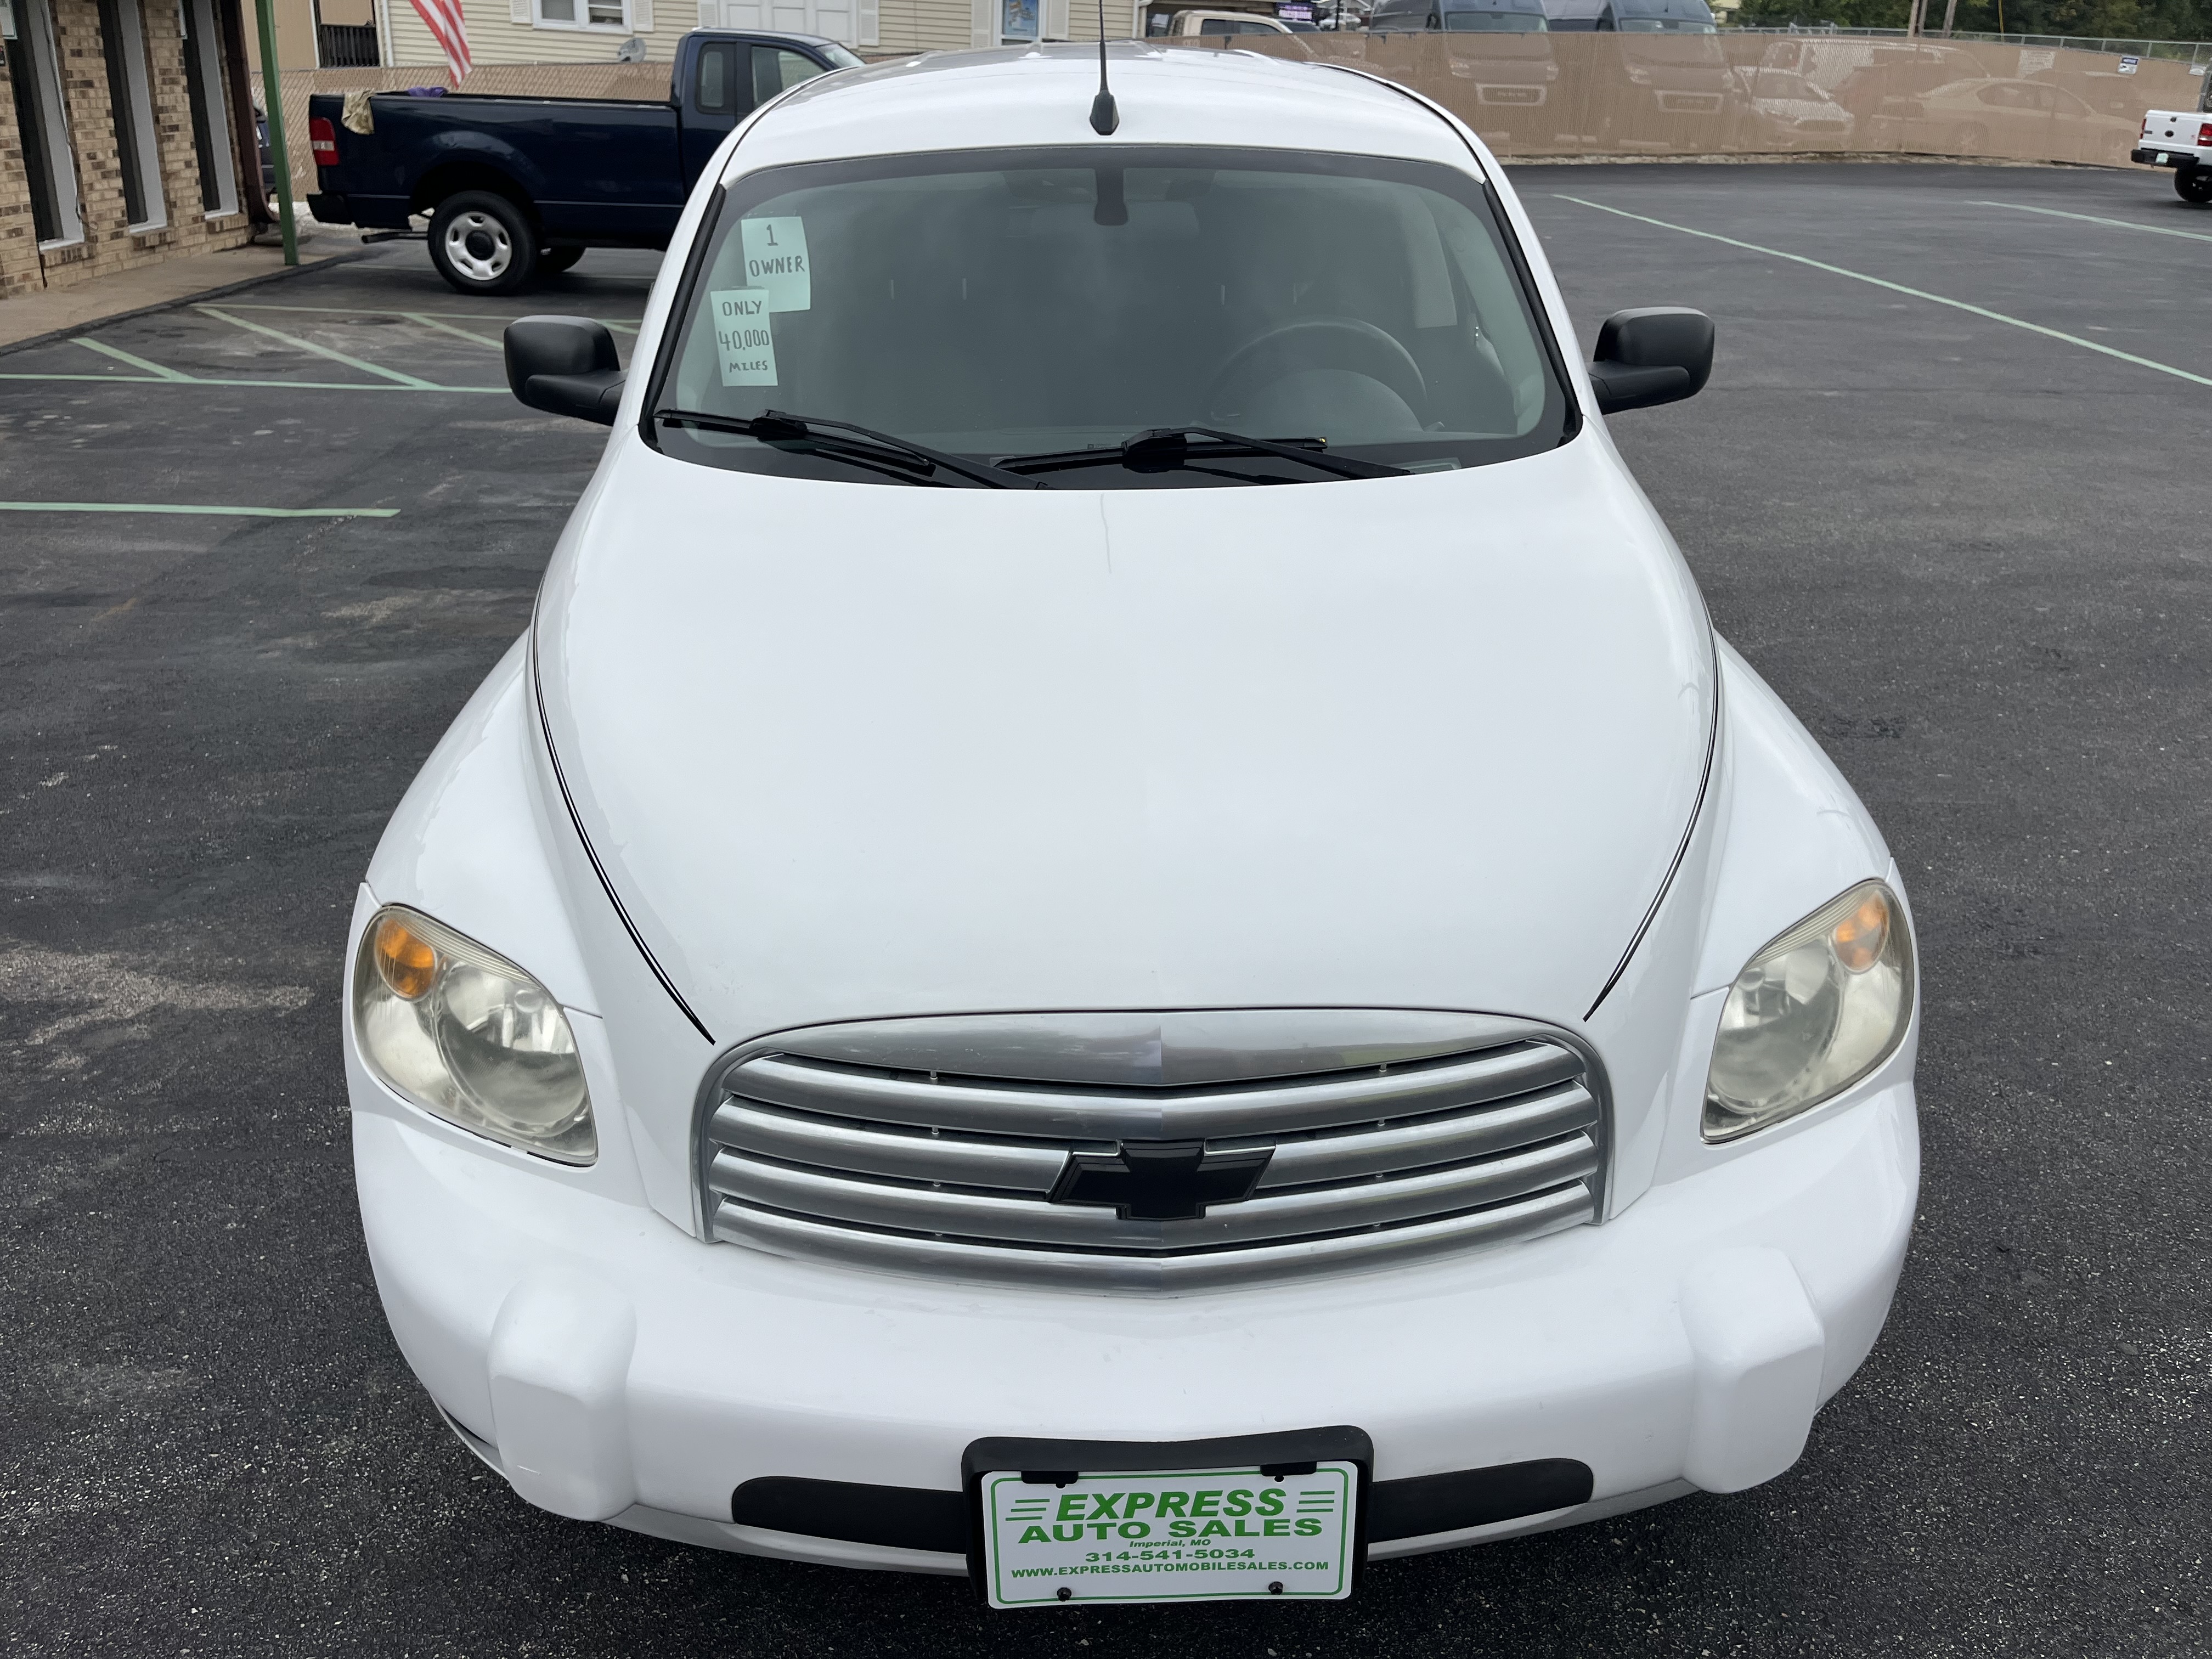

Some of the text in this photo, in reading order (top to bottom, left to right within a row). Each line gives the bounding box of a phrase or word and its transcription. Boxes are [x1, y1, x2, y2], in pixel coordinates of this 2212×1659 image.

[766, 224, 778, 246] 1
[749, 255, 805, 277] OWNER
[722, 301, 762, 317] ONLY
[729, 359, 768, 373] MILES
[1056, 1488, 1287, 1522] EXPRESS
[1018, 1518, 1323, 1544] AUTO SALES
[1129, 1539, 1186, 1548] Imperial,
[1085, 1549, 1256, 1562] 314-541-5034
[1011, 1562, 1329, 1578] WWW.EXPRESSAUTOMOBILESALES.COM
